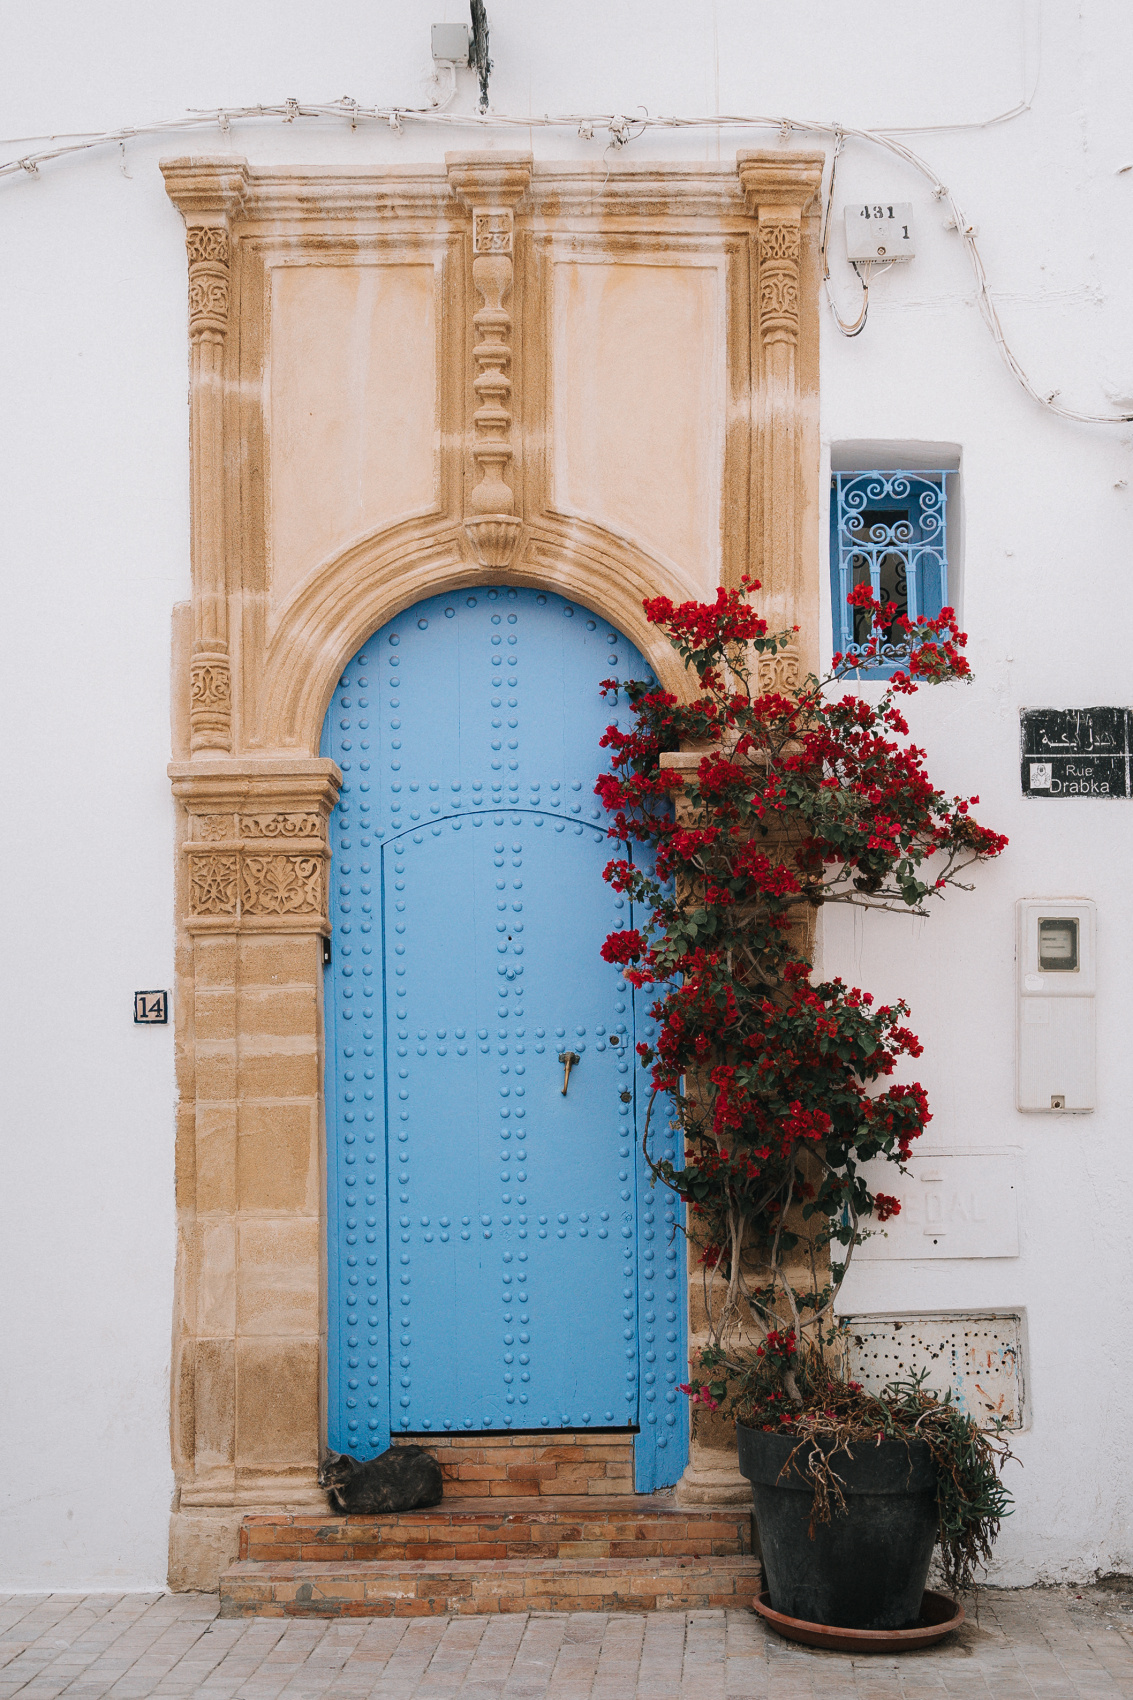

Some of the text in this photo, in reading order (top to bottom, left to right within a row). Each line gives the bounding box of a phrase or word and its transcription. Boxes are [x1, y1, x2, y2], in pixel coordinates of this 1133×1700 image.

[860, 205, 895, 219] 431
[902, 225, 910, 239] 1
[1066, 764, 1093, 777] Rue
[1049, 779, 1110, 793] Drabka
[138, 996, 164, 1018] 14
[884, 1190, 987, 1225] EDAL
